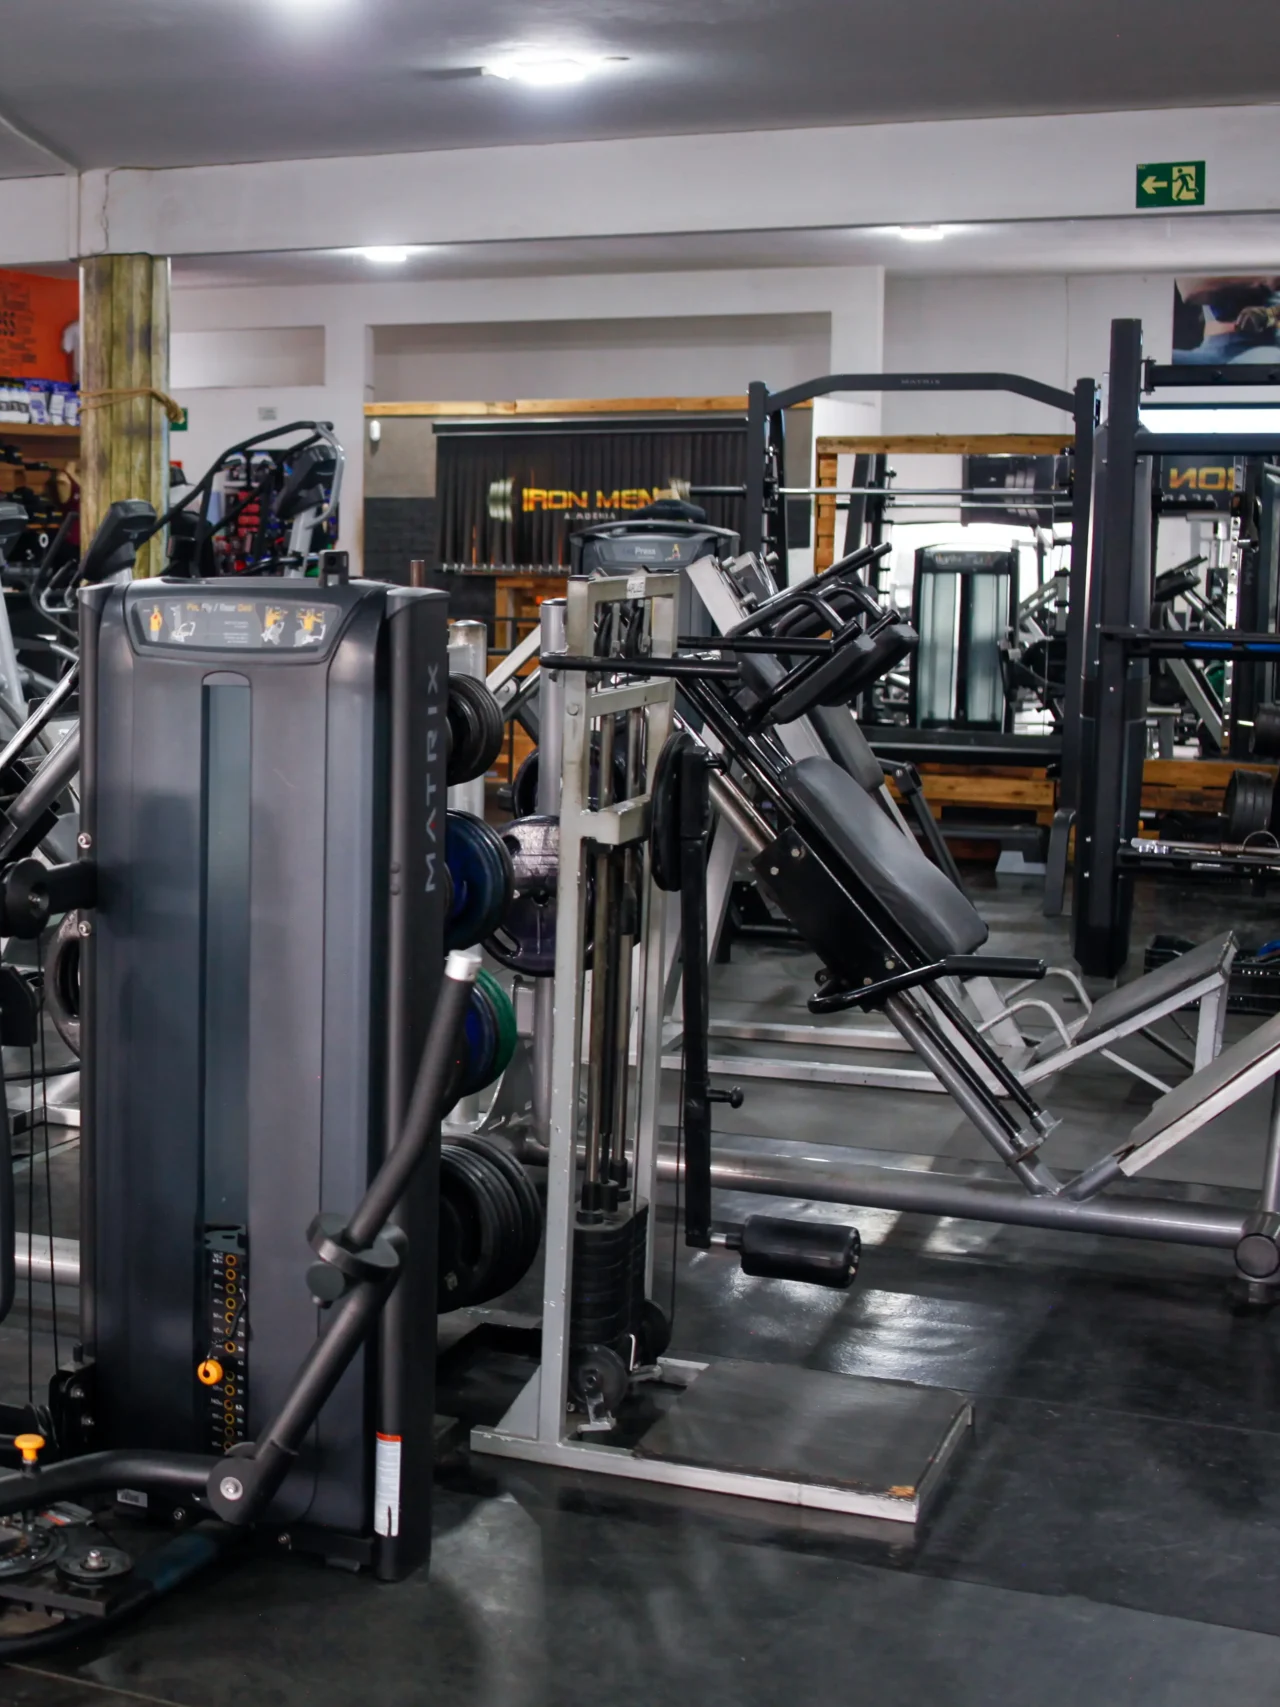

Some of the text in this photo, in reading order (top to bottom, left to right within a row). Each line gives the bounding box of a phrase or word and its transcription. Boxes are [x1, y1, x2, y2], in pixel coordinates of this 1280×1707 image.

[522, 487, 659, 512] IRON MEN
[564, 512, 616, 520] AADEMIA
[425, 663, 439, 892] MATRIX
